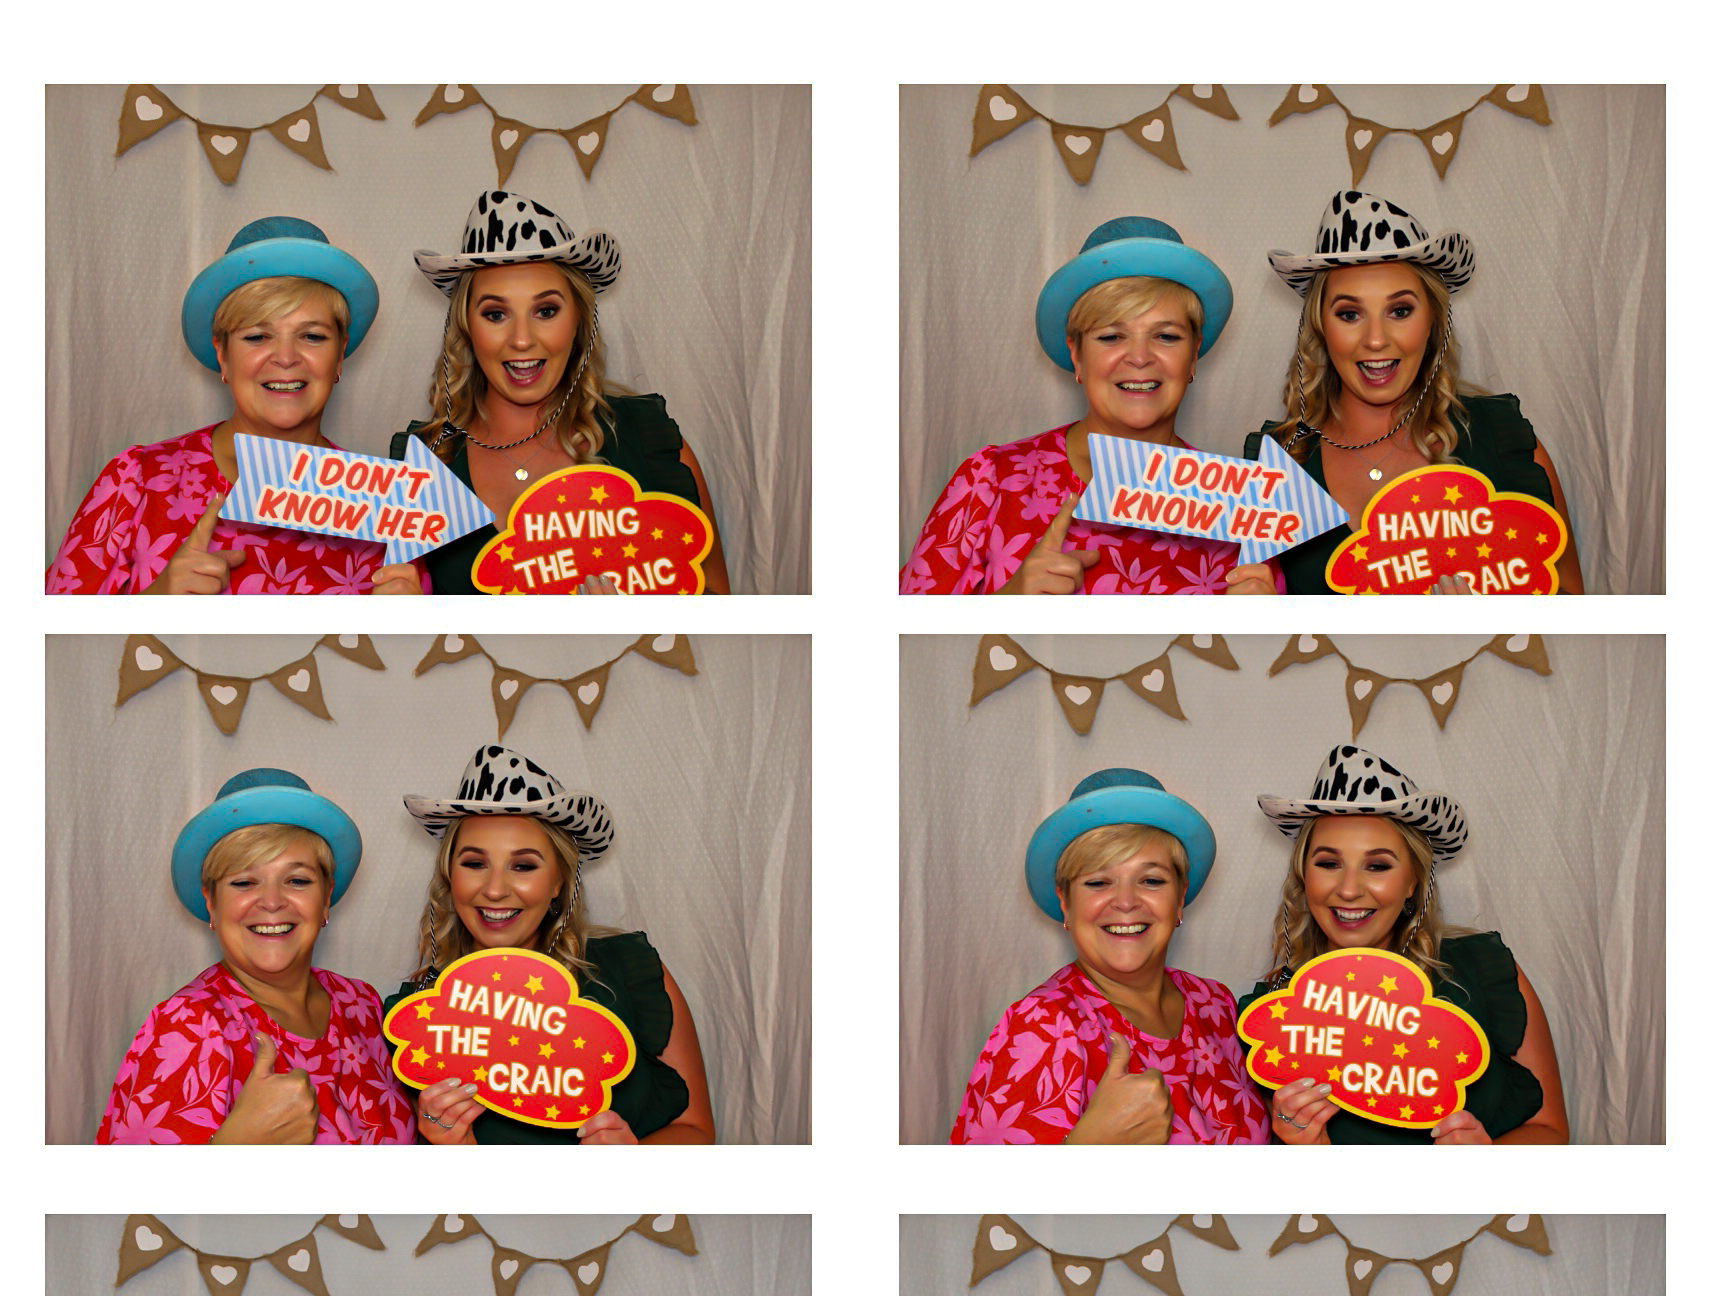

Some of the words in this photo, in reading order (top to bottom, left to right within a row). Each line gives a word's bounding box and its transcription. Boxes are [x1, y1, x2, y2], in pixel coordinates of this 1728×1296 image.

[289, 453, 309, 482] I
[320, 460, 431, 500] DON'T
[1143, 453, 1163, 482] I
[1174, 460, 1285, 500] DON'T
[258, 488, 369, 533] KNOW
[375, 508, 447, 544] HER
[523, 507, 641, 542] HAVING
[1112, 488, 1223, 533] KNOW
[1229, 508, 1301, 544] HER
[1377, 507, 1495, 542] HAVING
[513, 548, 579, 589] THE
[1367, 548, 1433, 589] THE
[448, 978, 568, 1036] HAVING
[1302, 978, 1422, 1036] HAVING
[426, 1024, 492, 1057] THE
[1280, 1024, 1346, 1057] THE
[487, 1061, 586, 1098] CRAIC
[1341, 1061, 1440, 1098] CRAIC
